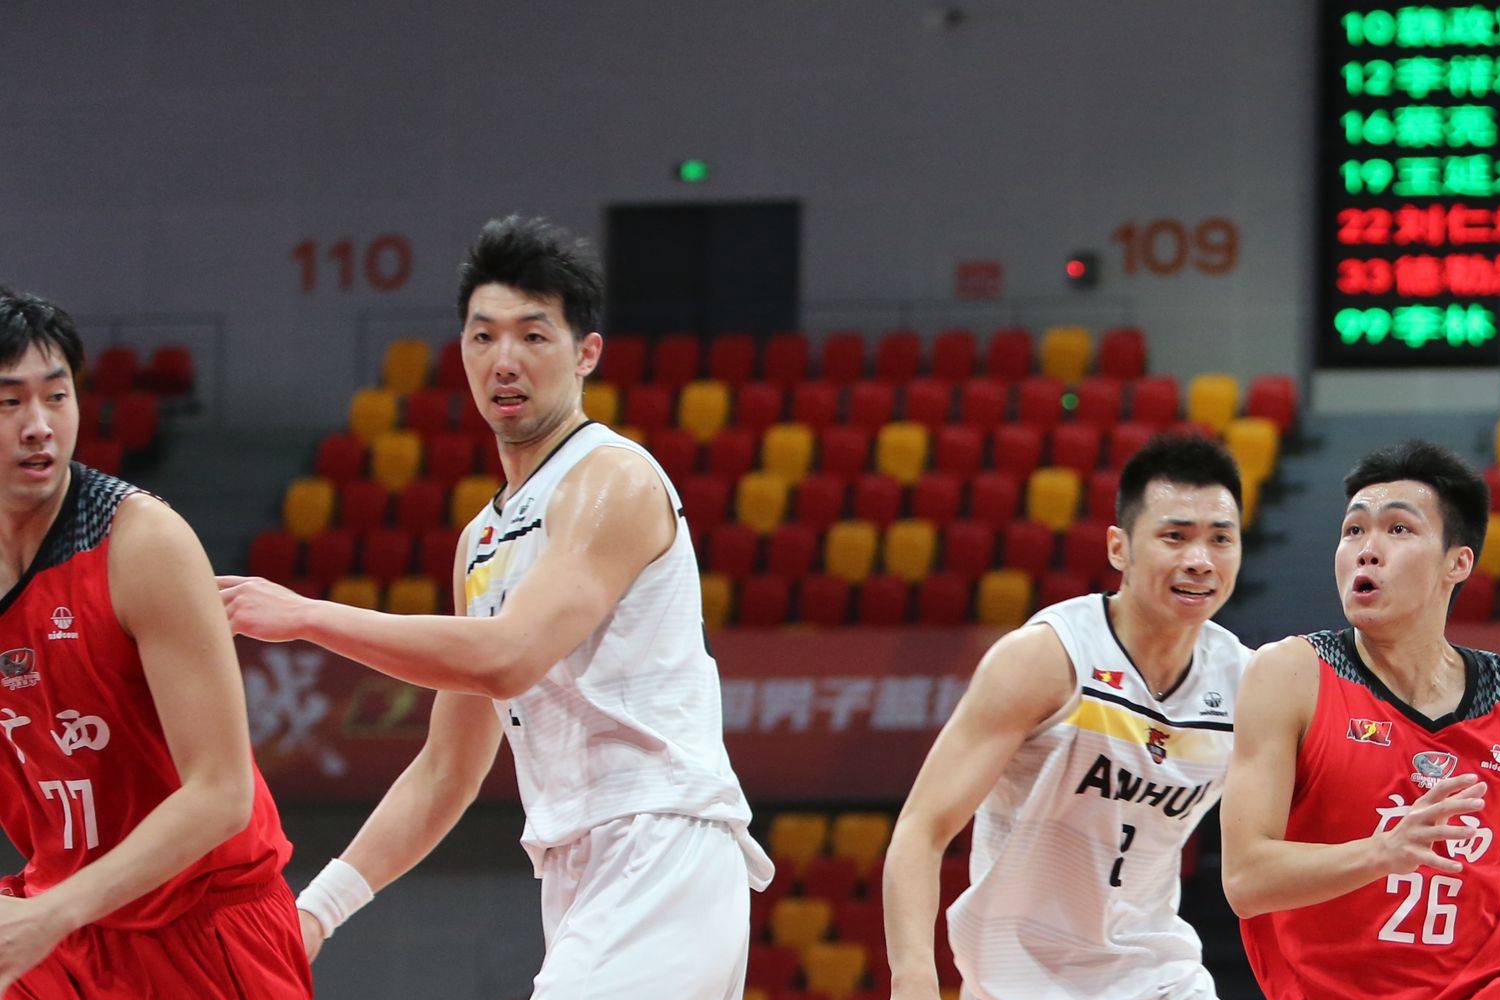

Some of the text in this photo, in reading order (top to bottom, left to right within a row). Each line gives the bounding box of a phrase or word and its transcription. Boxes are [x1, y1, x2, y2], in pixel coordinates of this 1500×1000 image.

[292, 235, 412, 291] 110
[1113, 217, 1239, 276] 109
[38, 778, 99, 850] 77
[1377, 870, 1463, 945] 26
